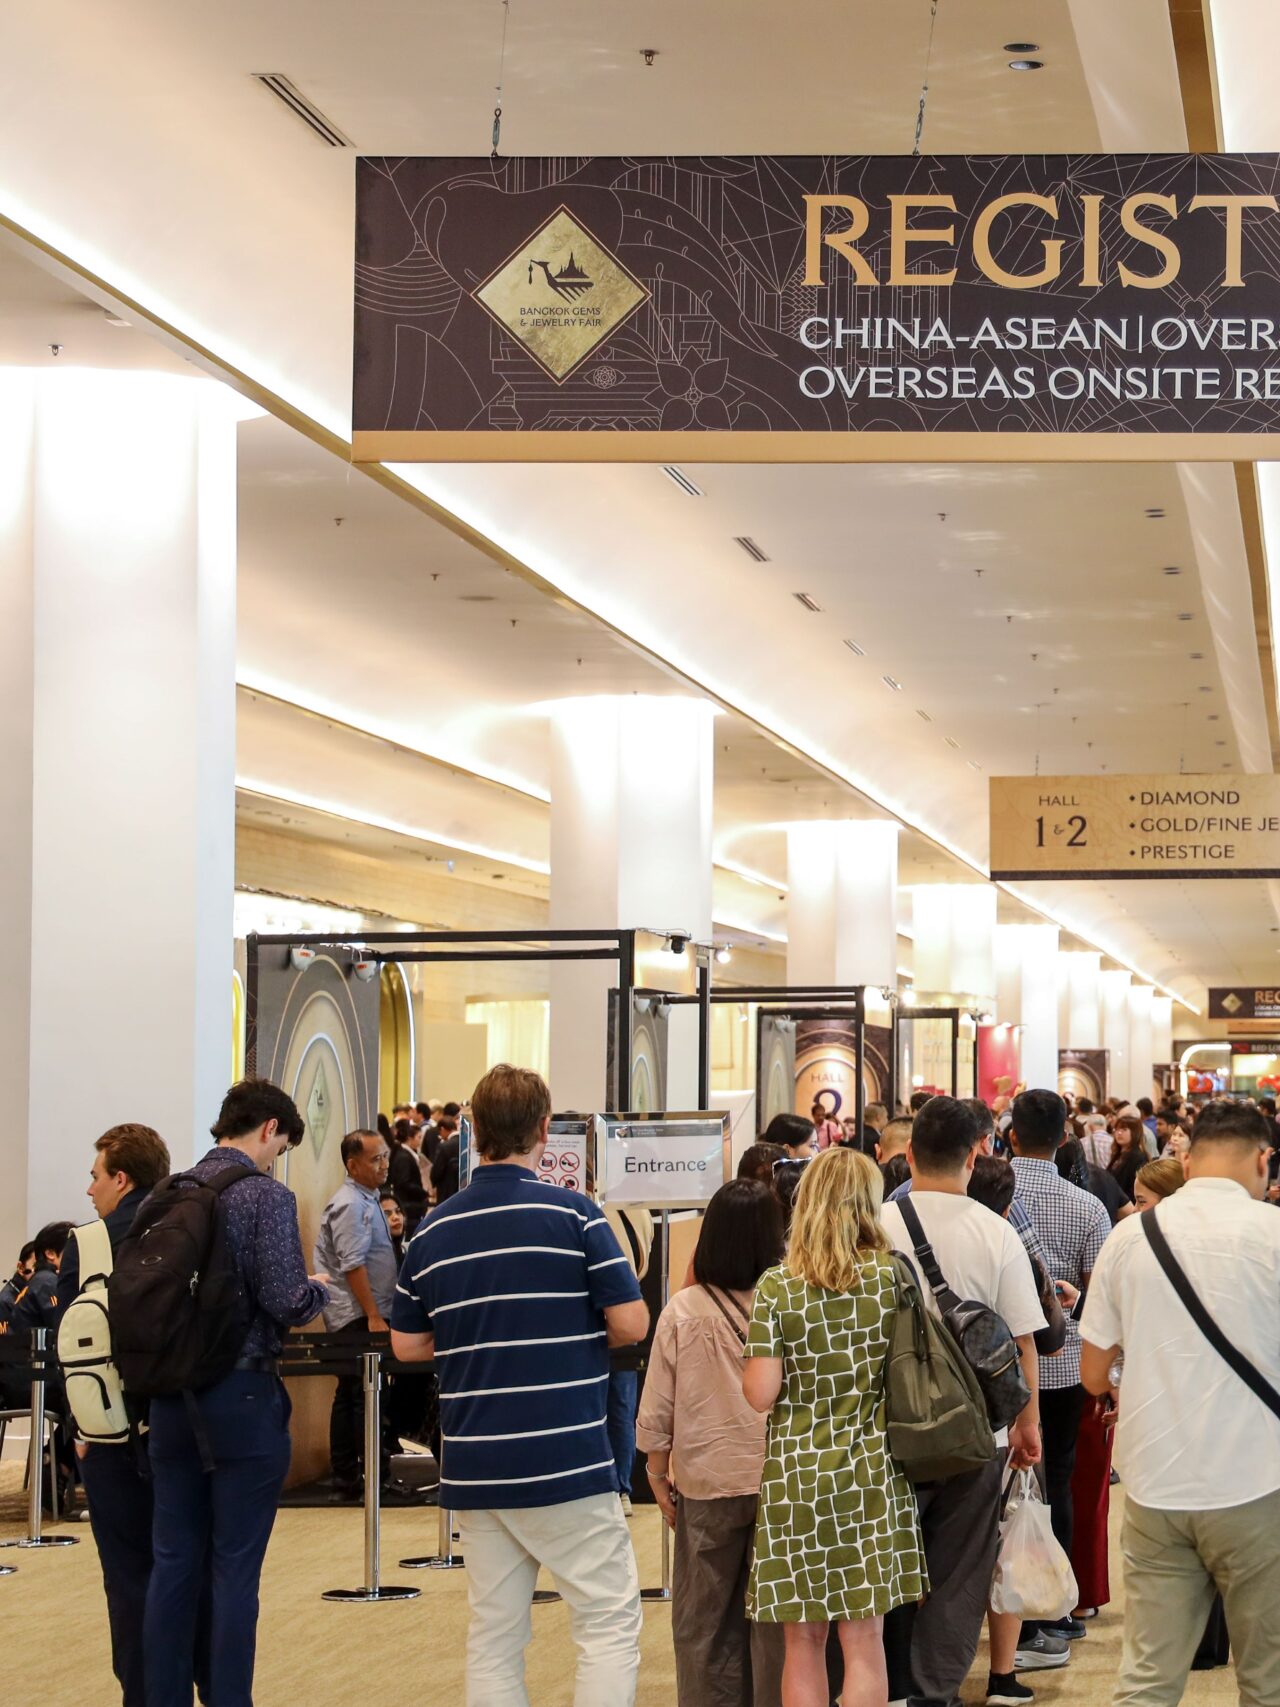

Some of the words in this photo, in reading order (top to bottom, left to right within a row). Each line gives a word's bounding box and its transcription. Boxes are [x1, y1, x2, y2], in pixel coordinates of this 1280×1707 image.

[520, 307, 570, 315] BANGKOK
[572, 307, 601, 315] GEMS
[530, 319, 576, 327] JEWELRY
[579, 319, 602, 327] FAIR
[799, 367, 1036, 399] OVERSEAS
[1048, 367, 1220, 400] ONSITE
[1038, 795, 1080, 807] HALL
[1140, 790, 1240, 805] DIAMOND
[1034, 815, 1046, 848] 1
[1067, 815, 1088, 847] 2
[1140, 817, 1252, 833] GOLD/FINE
[1140, 844, 1235, 860] PRESTIGE
[811, 1073, 844, 1083] HALL
[625, 1156, 706, 1173] Entrance
